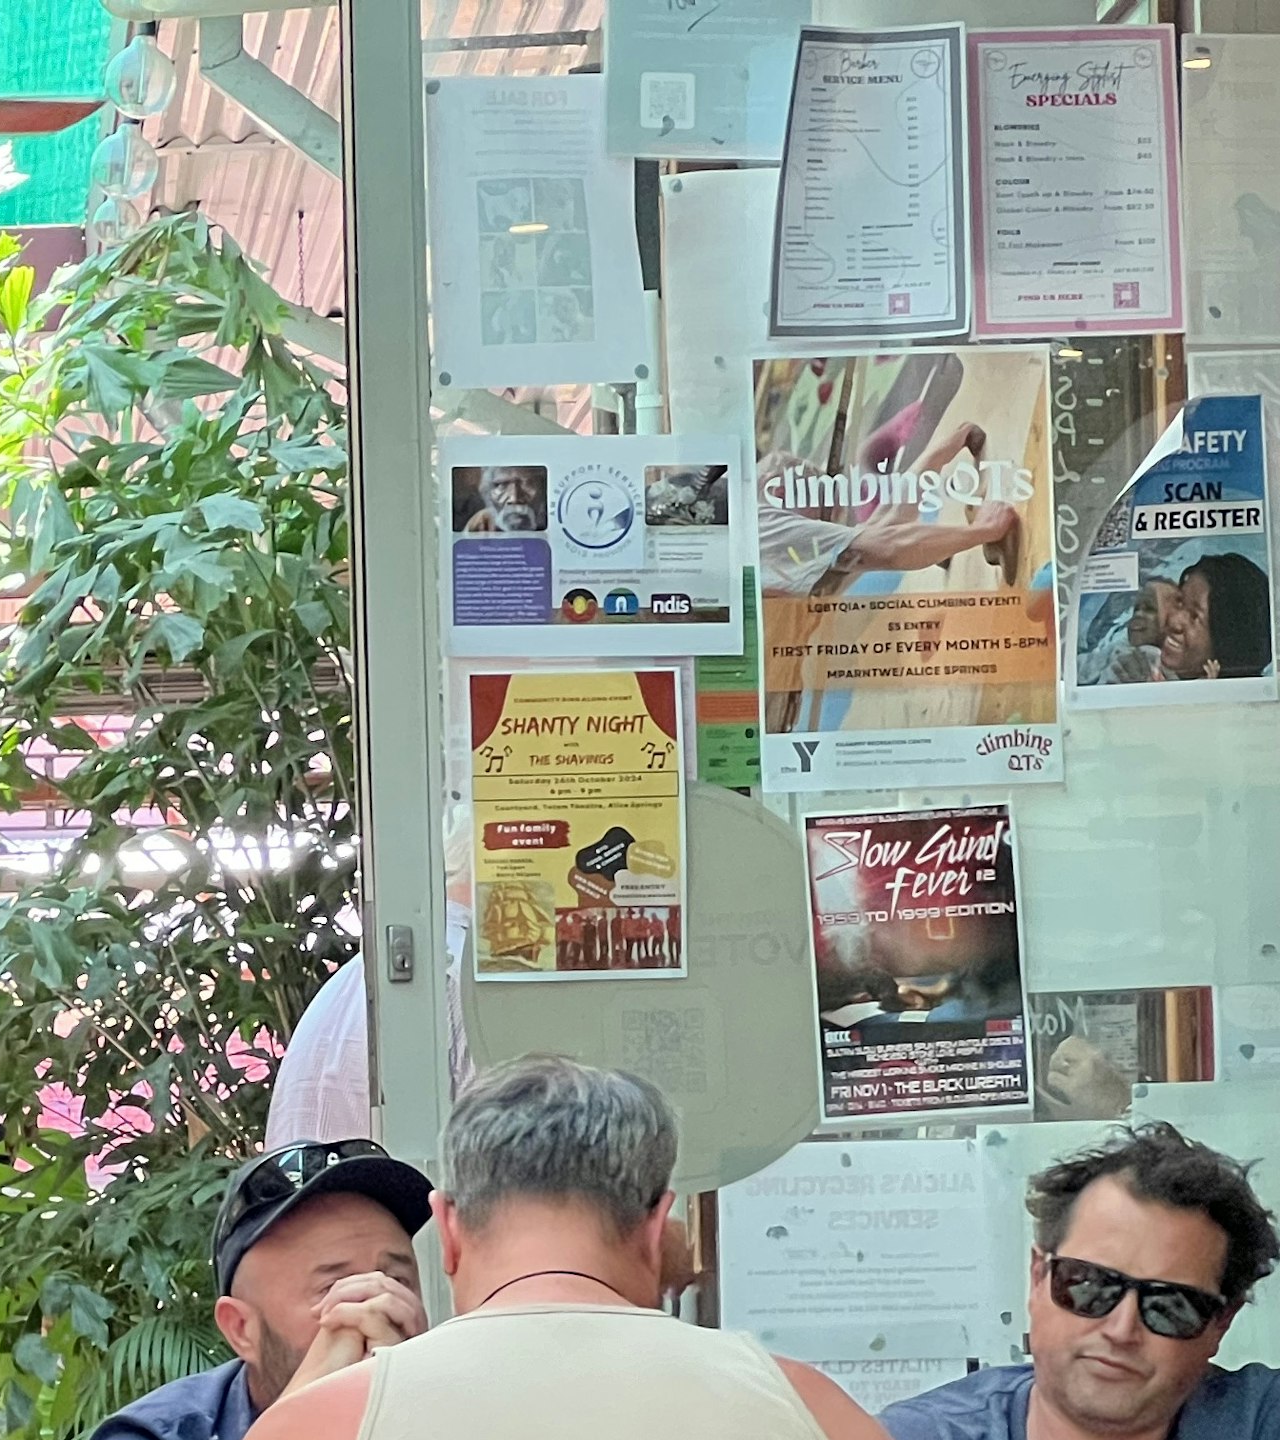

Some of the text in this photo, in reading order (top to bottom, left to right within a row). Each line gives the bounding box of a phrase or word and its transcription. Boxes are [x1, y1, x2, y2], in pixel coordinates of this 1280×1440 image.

[823, 74, 904, 85] SERVICE MENU
[1009, 60, 1136, 94] Emerging Stylist
[1026, 92, 1118, 107] SPECIALS
[1177, 430, 1247, 455] AFETY
[1164, 481, 1223, 503] SCAN
[1135, 507, 1260, 532] & REGISTER
[652, 595, 689, 614] ndis
[870, 600, 914, 611] SOCIAL
[917, 598, 976, 609] CLIMBING
[904, 621, 940, 631] ENTRY
[772, 637, 1049, 658] FIRST FRIDAY OF EVERY MONTH 5-8PM
[827, 664, 998, 679] MPARNTWE/ALICE SPRINGS
[501, 714, 648, 737] SHANTY NIGHT
[976, 728, 1053, 757] climbing
[529, 753, 614, 766] THE SHAVINGS
[792, 741, 820, 773] Y
[1007, 754, 1044, 772] QTs
[509, 777, 552, 786] Saturday
[579, 776, 616, 784] October
[631, 801, 663, 810] Springs
[497, 823, 557, 835] Fun family
[512, 837, 544, 846] event
[816, 821, 1004, 881] Slow Grind
[885, 866, 973, 920] Fever
[865, 911, 889, 923] TO
[897, 907, 941, 921] 1999
[945, 902, 1015, 917] EDITION
[831, 1085, 852, 1098] FRI
[853, 1083, 880, 1096] NOV
[894, 1081, 921, 1095] THE
[923, 1077, 963, 1092] BLACK
[965, 1074, 1020, 1090] WREATH
